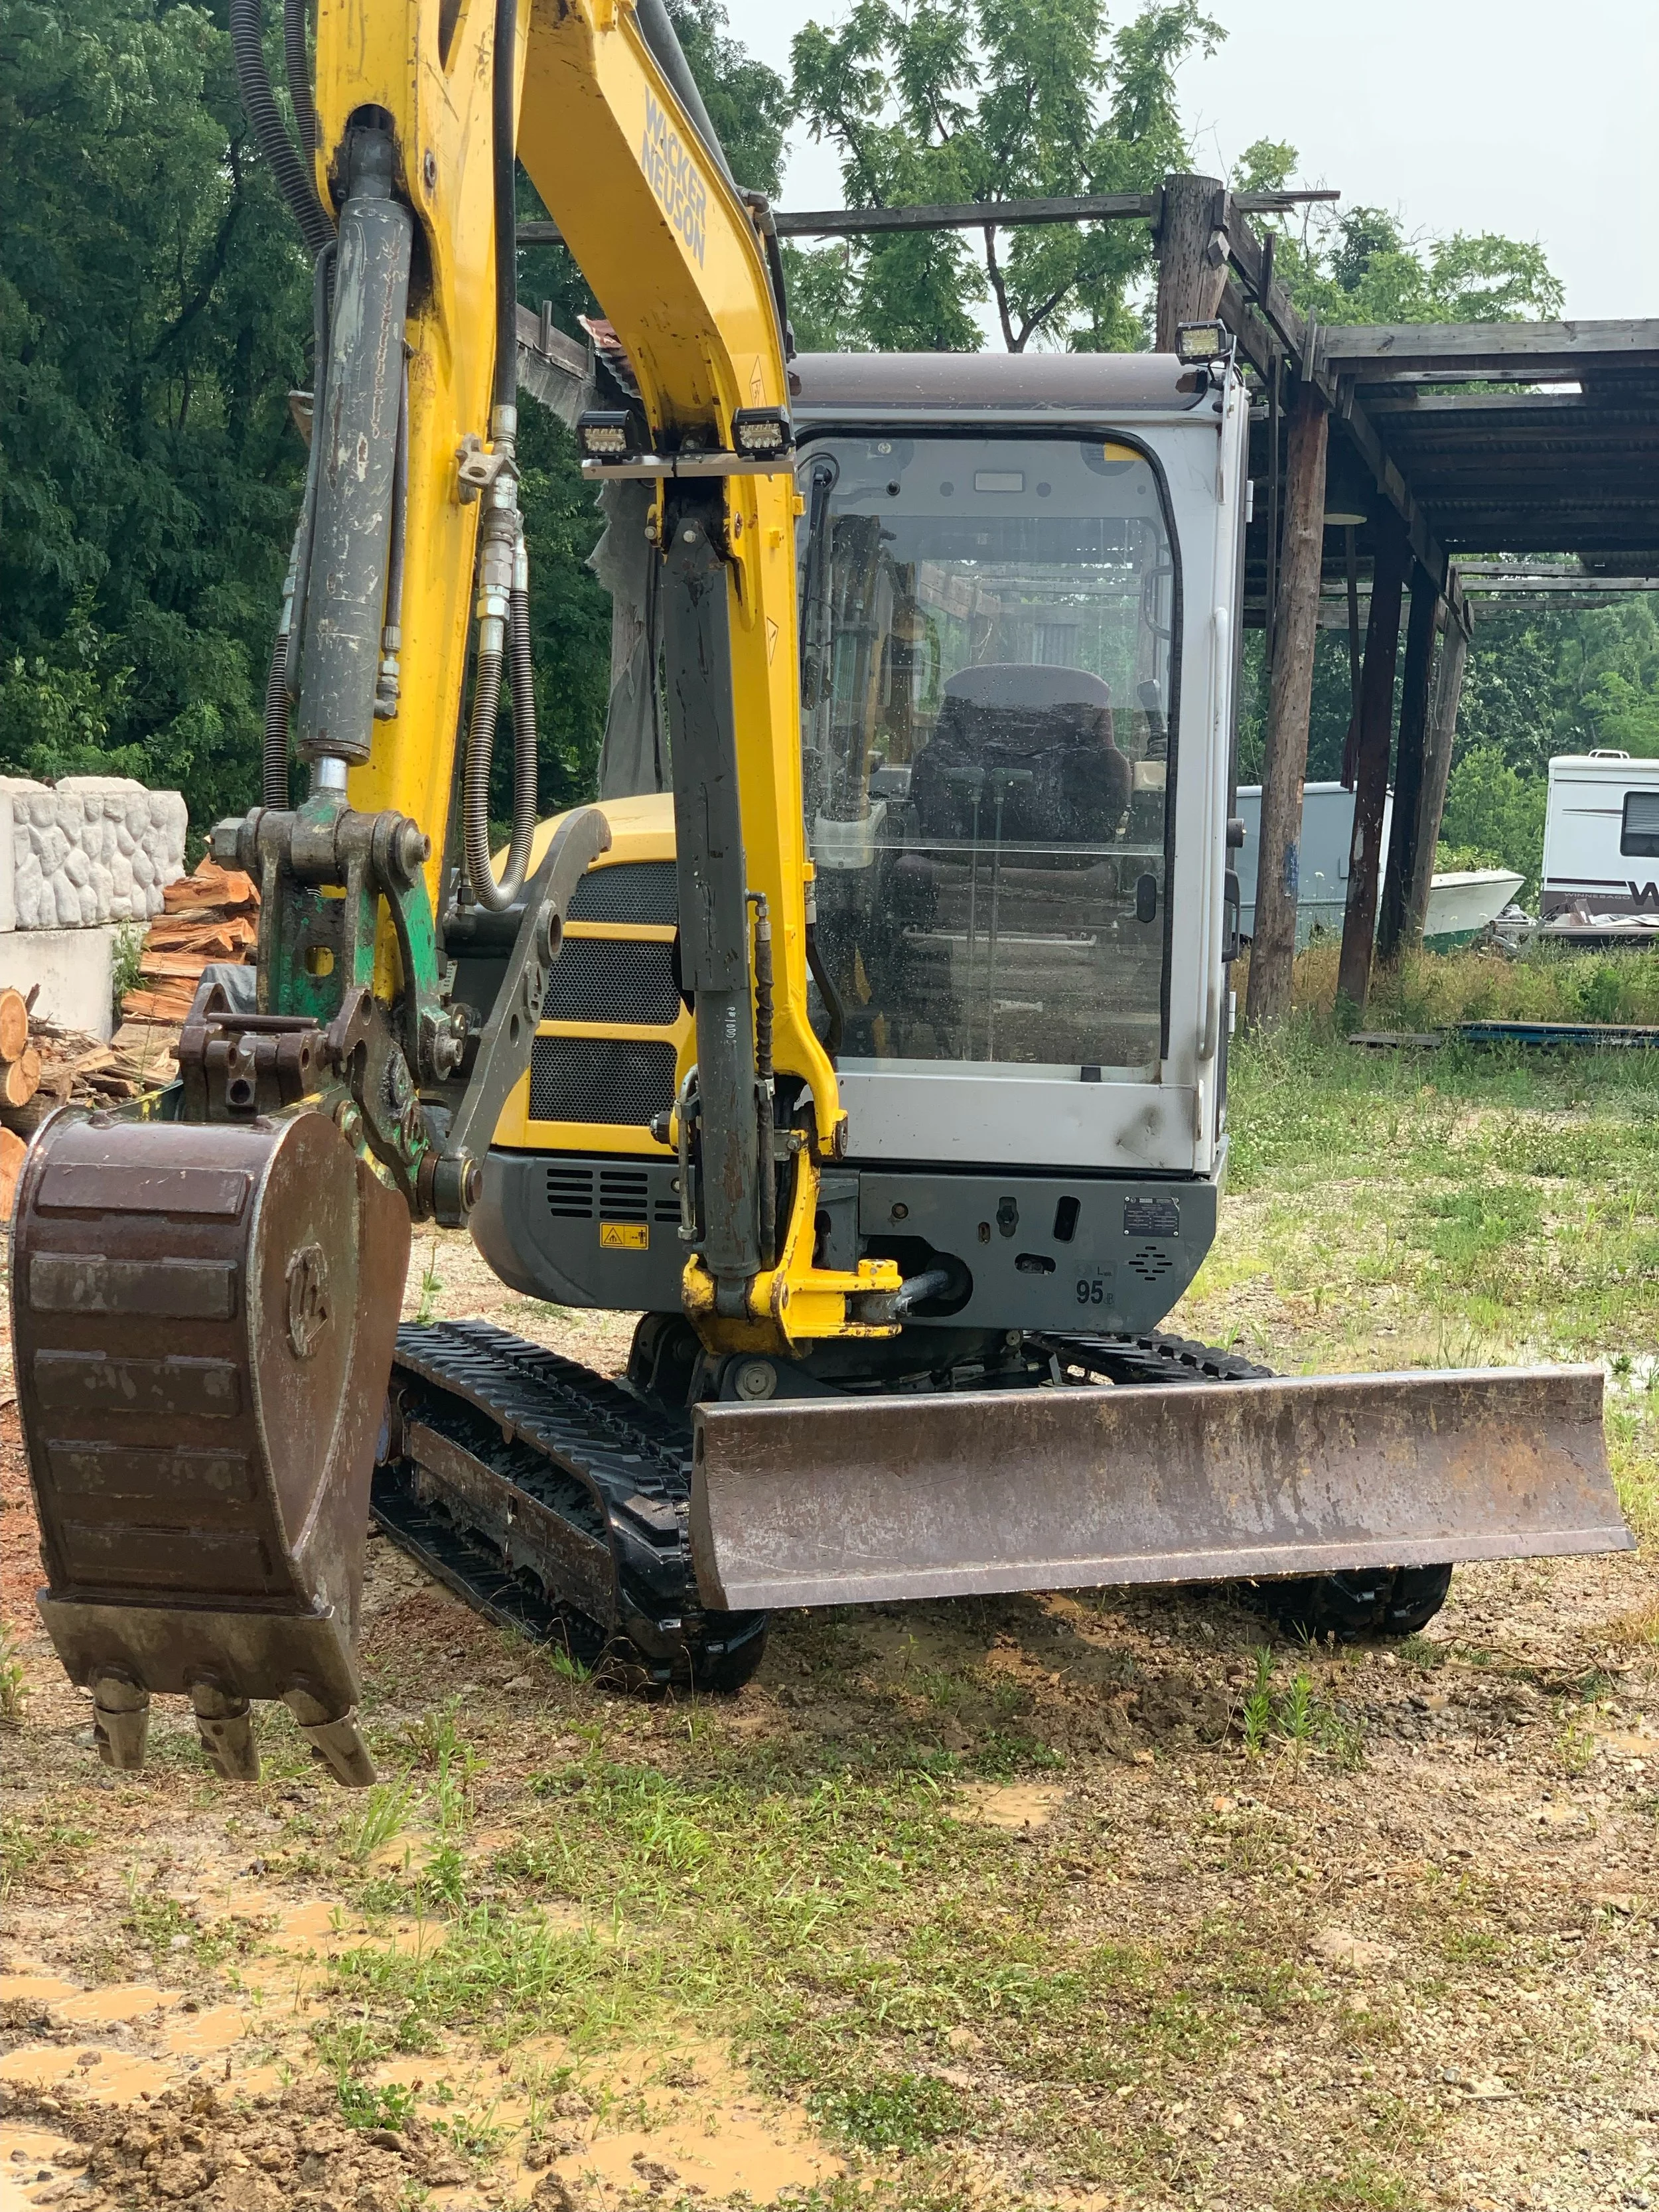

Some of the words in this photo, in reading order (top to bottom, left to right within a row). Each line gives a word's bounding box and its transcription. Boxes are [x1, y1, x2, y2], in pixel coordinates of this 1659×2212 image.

[645, 84, 706, 232] WACKER
[641, 129, 705, 271] NEUSON
[1564, 892, 1630, 901] WINNEBAGO
[1076, 1280, 1104, 1304] 95
